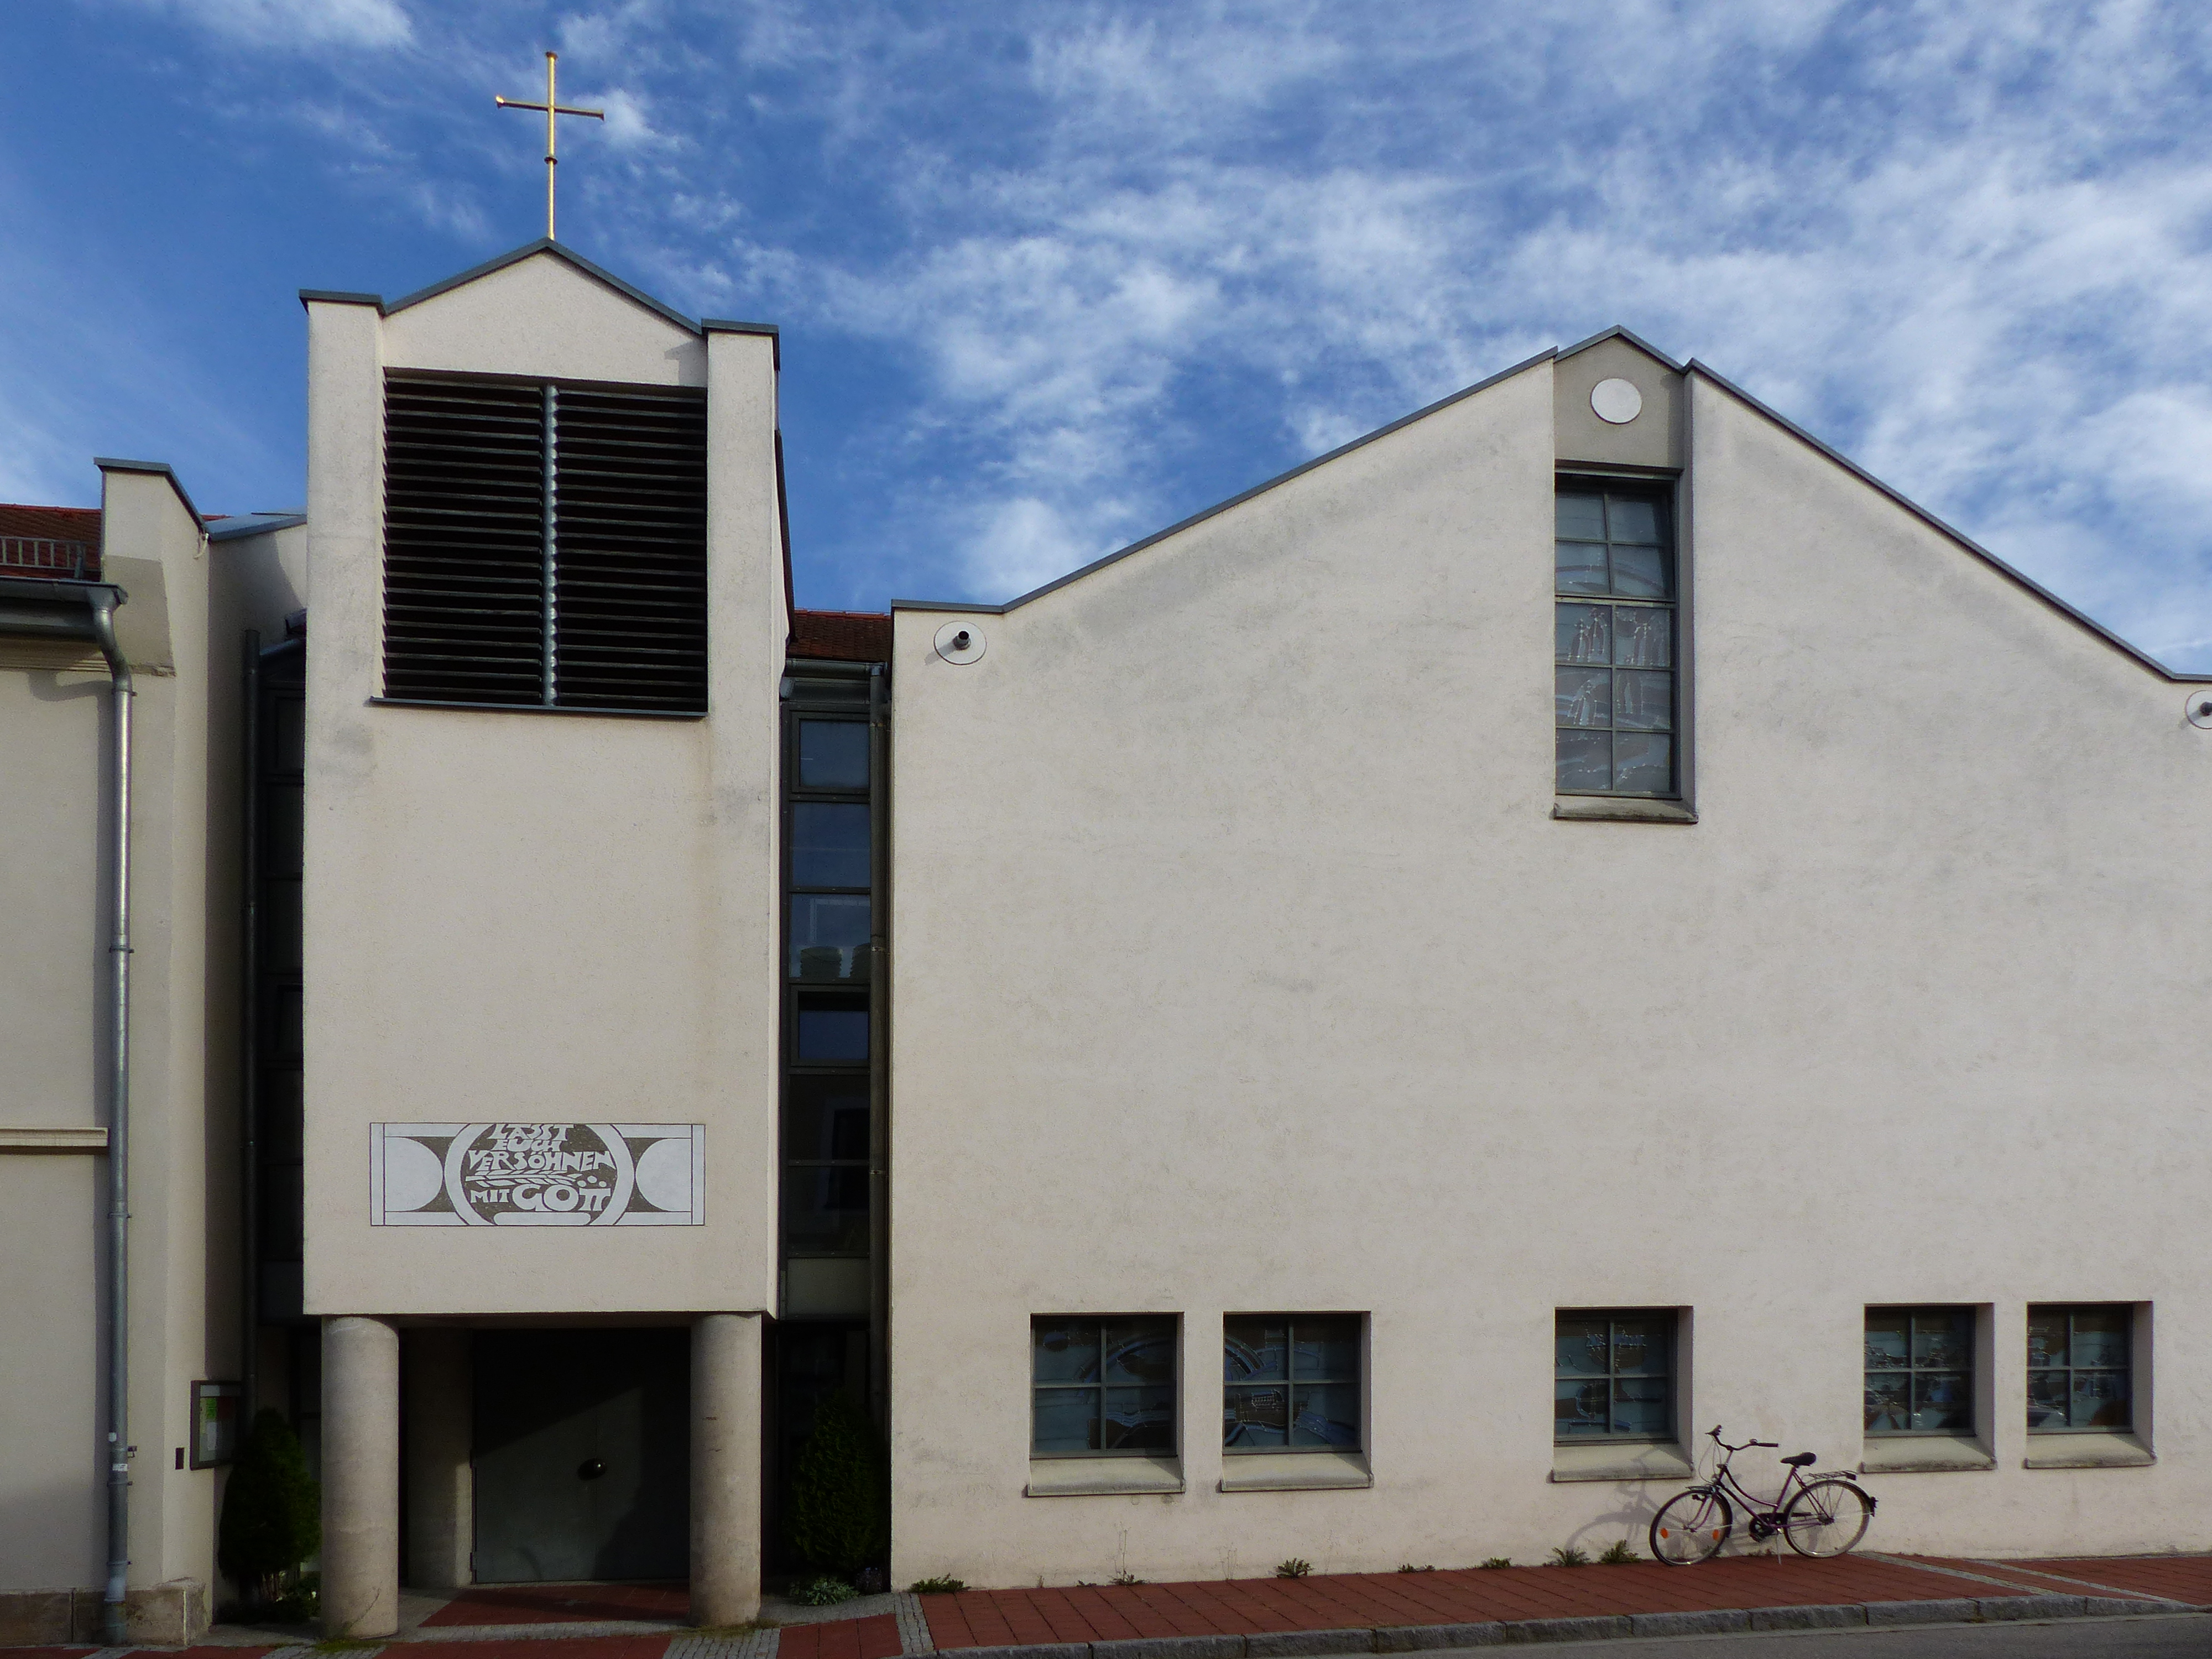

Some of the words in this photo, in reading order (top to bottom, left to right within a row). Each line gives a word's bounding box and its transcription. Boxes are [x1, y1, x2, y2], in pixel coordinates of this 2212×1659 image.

[487, 1124, 574, 1141] LASST
[492, 1139, 562, 1152] EUCH
[468, 1150, 617, 1171] VERSÖHNEN
[470, 1189, 510, 1203] MIT
[512, 1183, 611, 1212] GOTT
